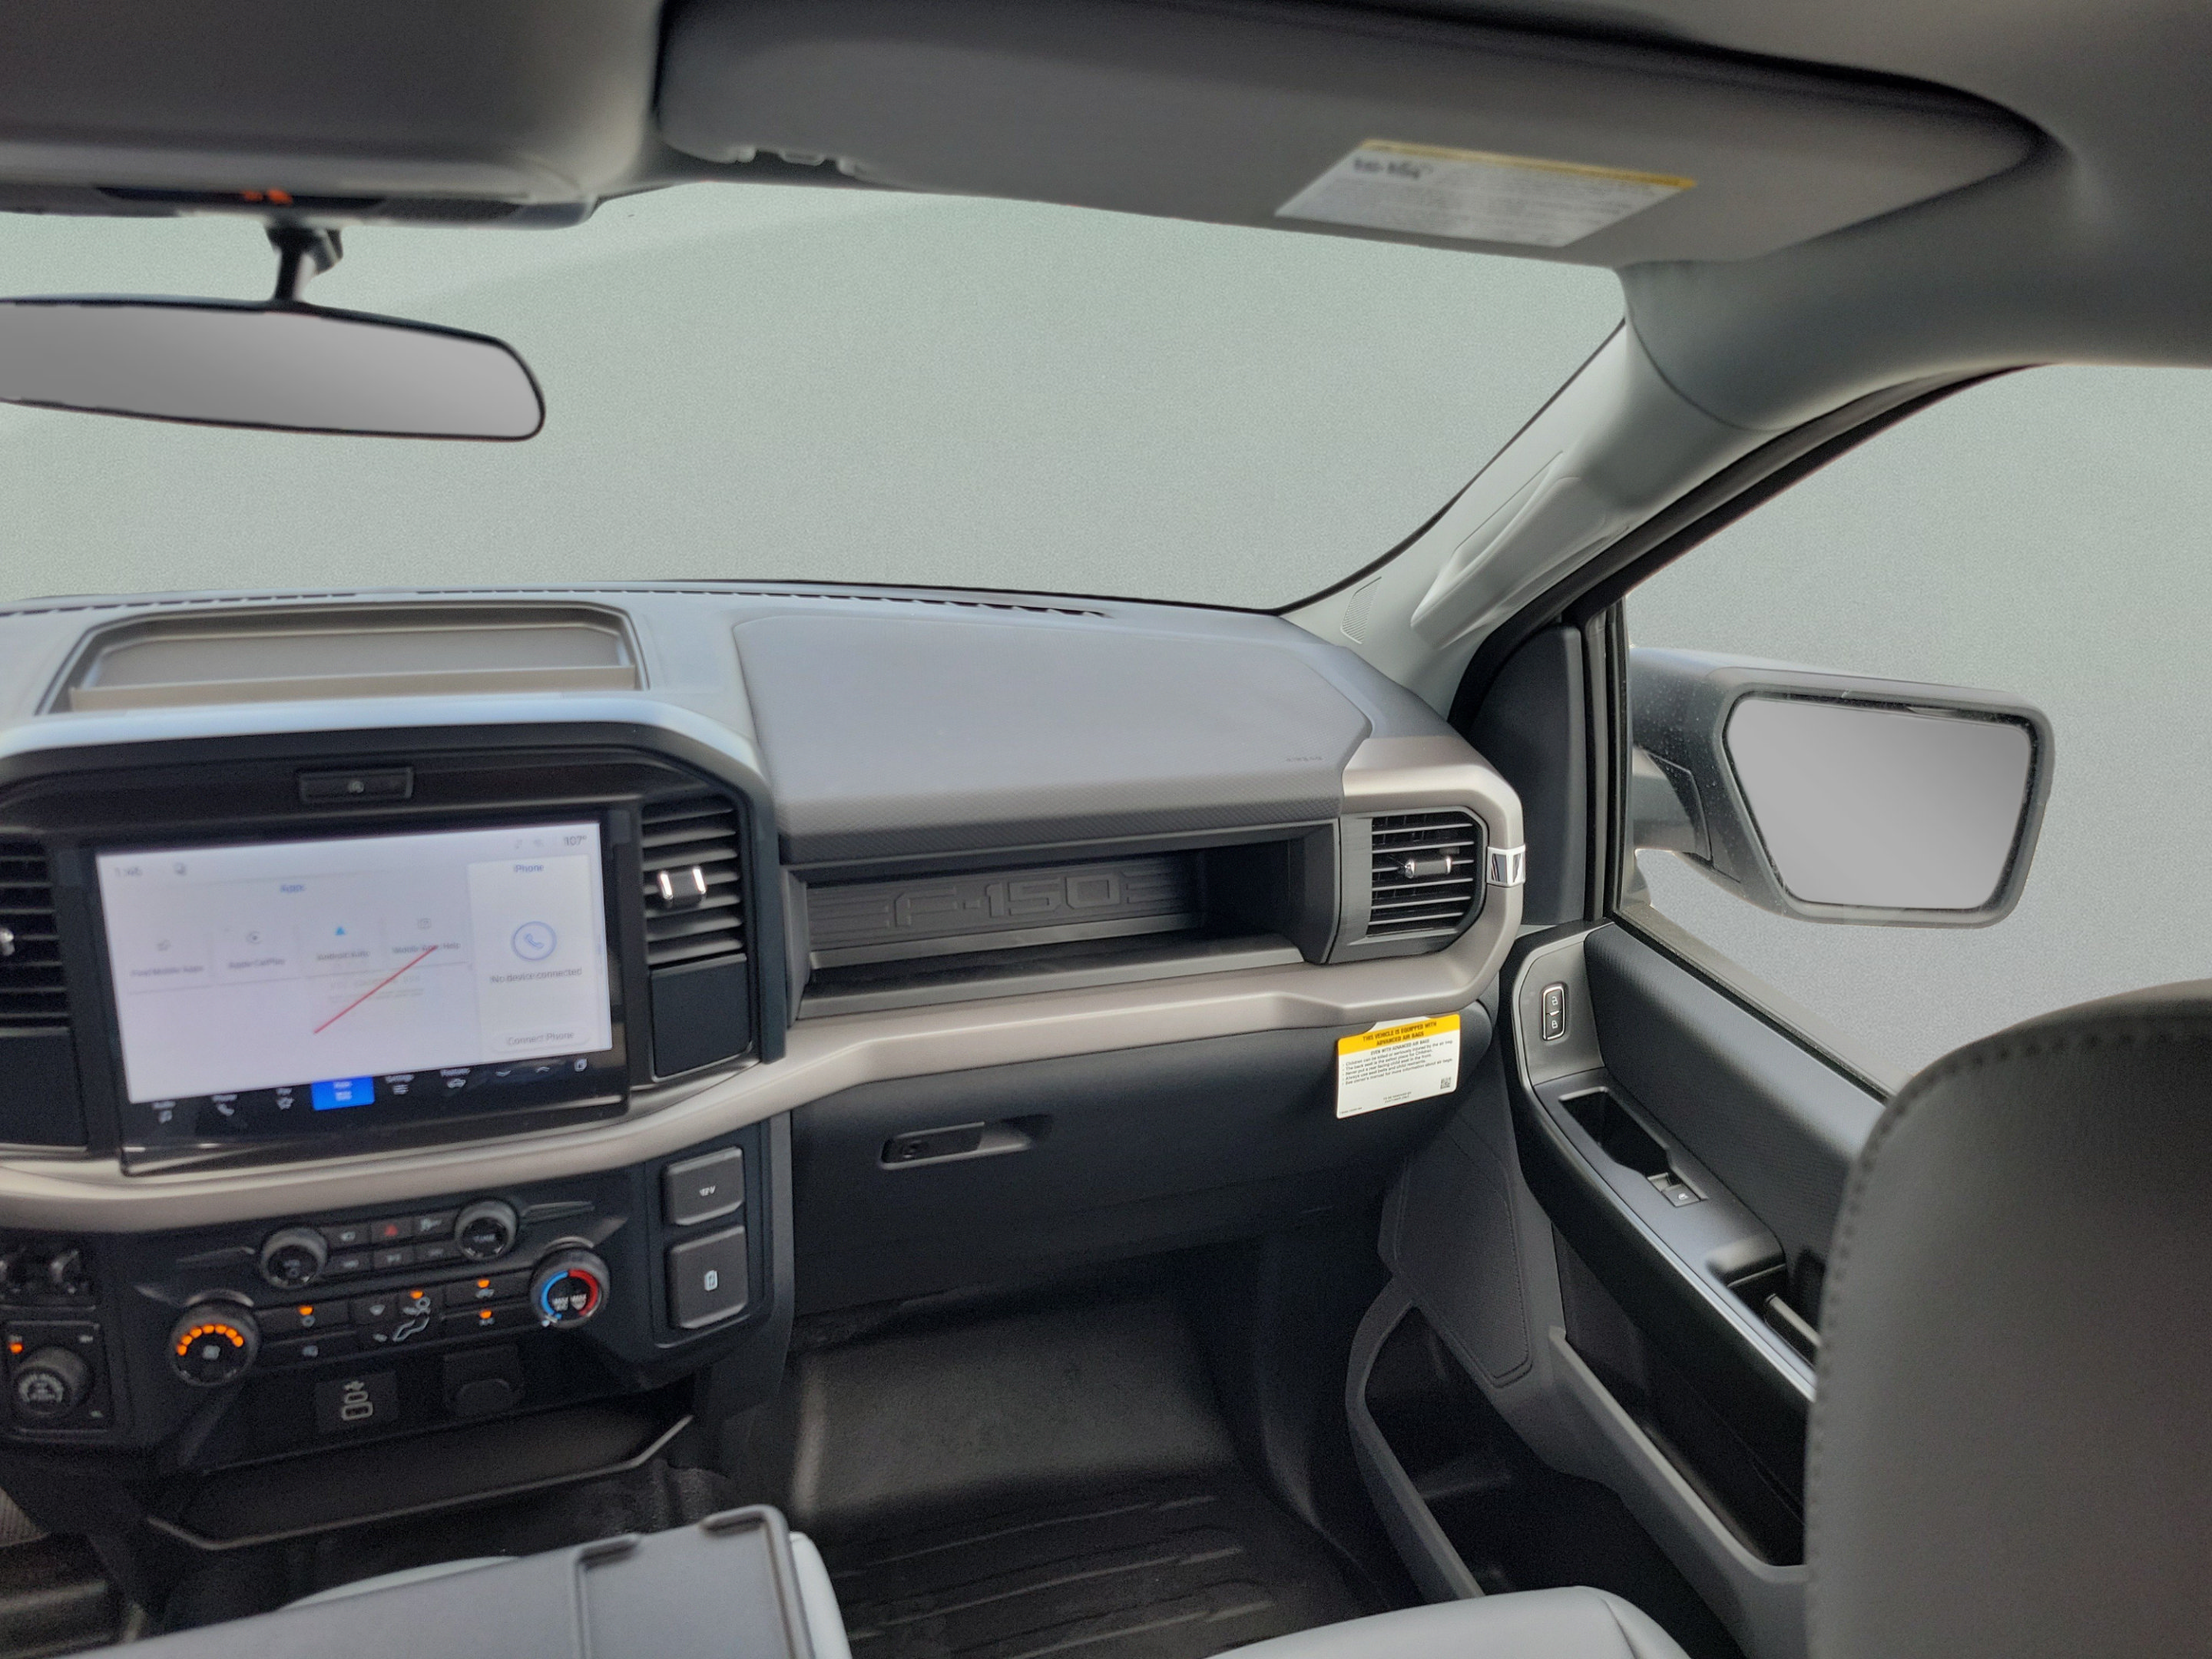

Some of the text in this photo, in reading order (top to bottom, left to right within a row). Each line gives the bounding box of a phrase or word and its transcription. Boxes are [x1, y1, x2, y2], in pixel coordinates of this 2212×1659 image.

[514, 864, 545, 873] Phone
[893, 872, 1121, 928] F-150
[490, 967, 582, 984] No device connected
[1375, 1031, 1394, 1039] VEHICLE
[1401, 1025, 1423, 1035] EQUIPPED
[1425, 1022, 1437, 1030] WITH
[507, 1031, 575, 1045] Connect Phone
[1376, 1037, 1401, 1046] ADVANCED
[1392, 1042, 1411, 1051] ADVANCED
